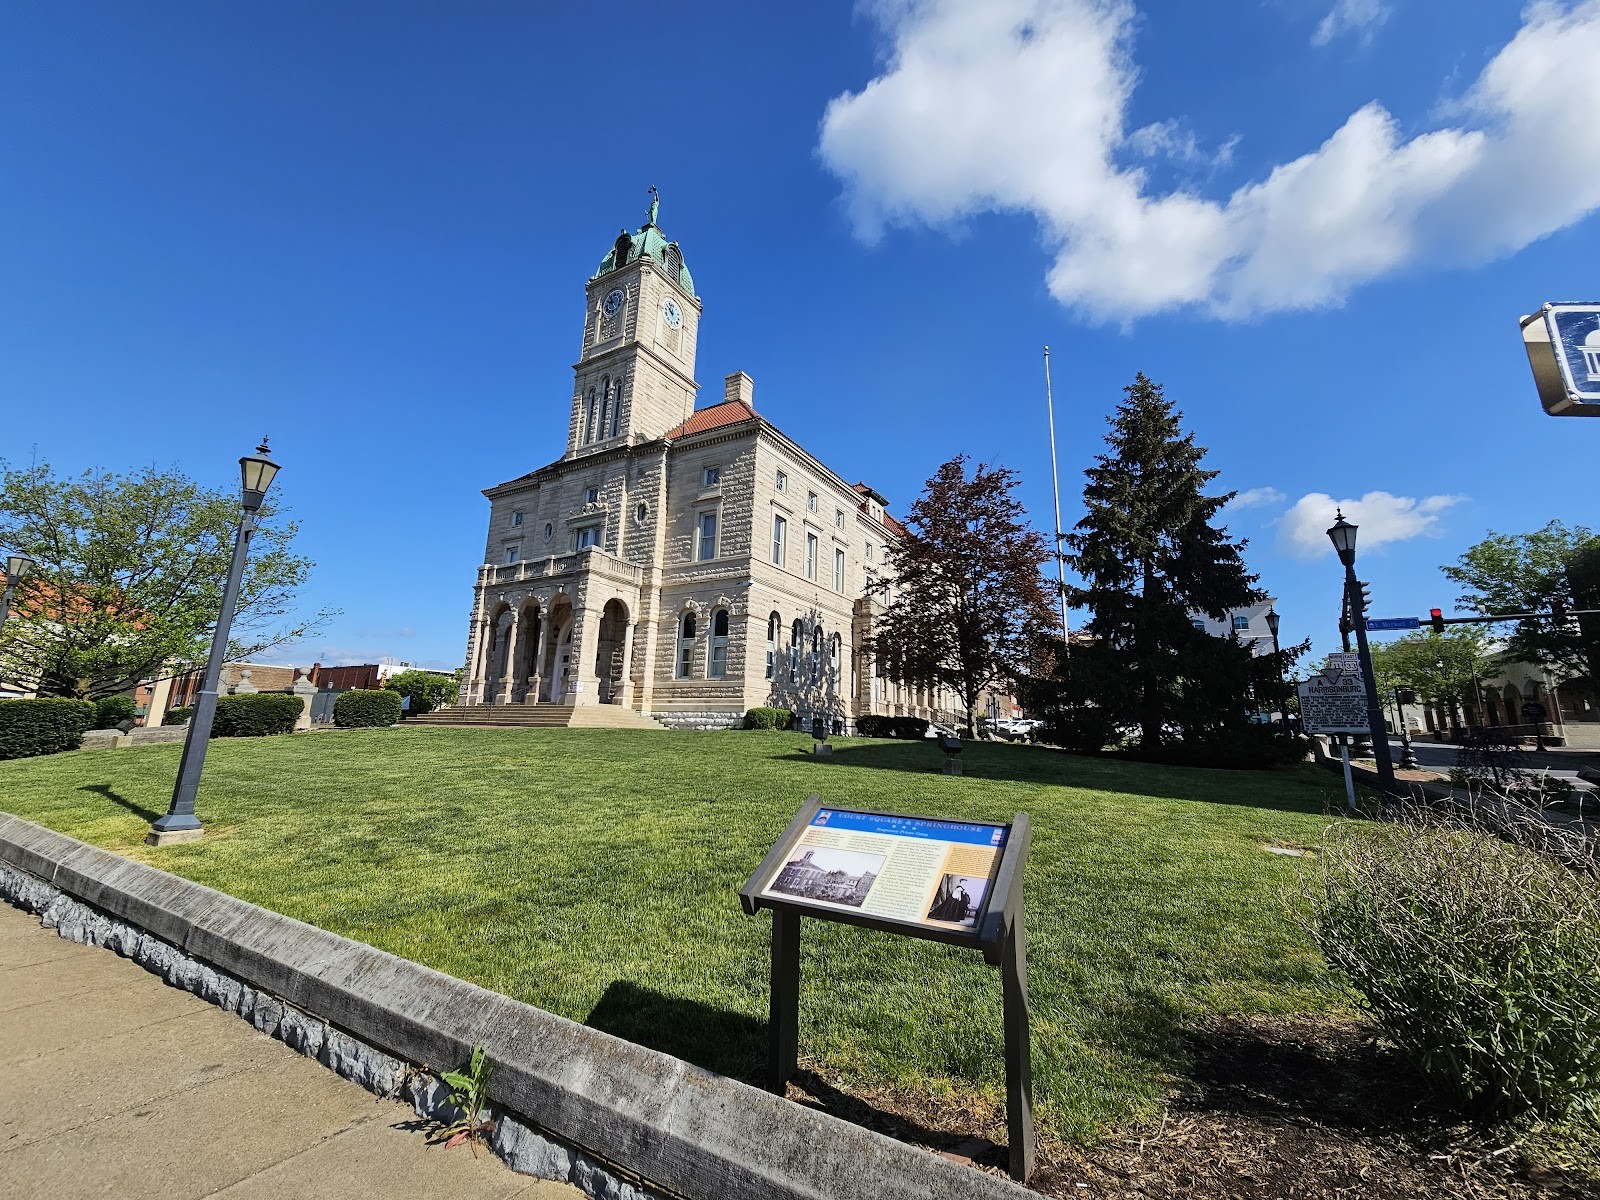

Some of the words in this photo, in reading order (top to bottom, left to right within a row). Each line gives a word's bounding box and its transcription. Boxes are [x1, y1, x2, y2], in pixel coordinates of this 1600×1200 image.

[838, 813, 867, 821] COURT
[869, 815, 904, 825] SQUARE
[914, 820, 983, 833] SPRINGHOUSE
